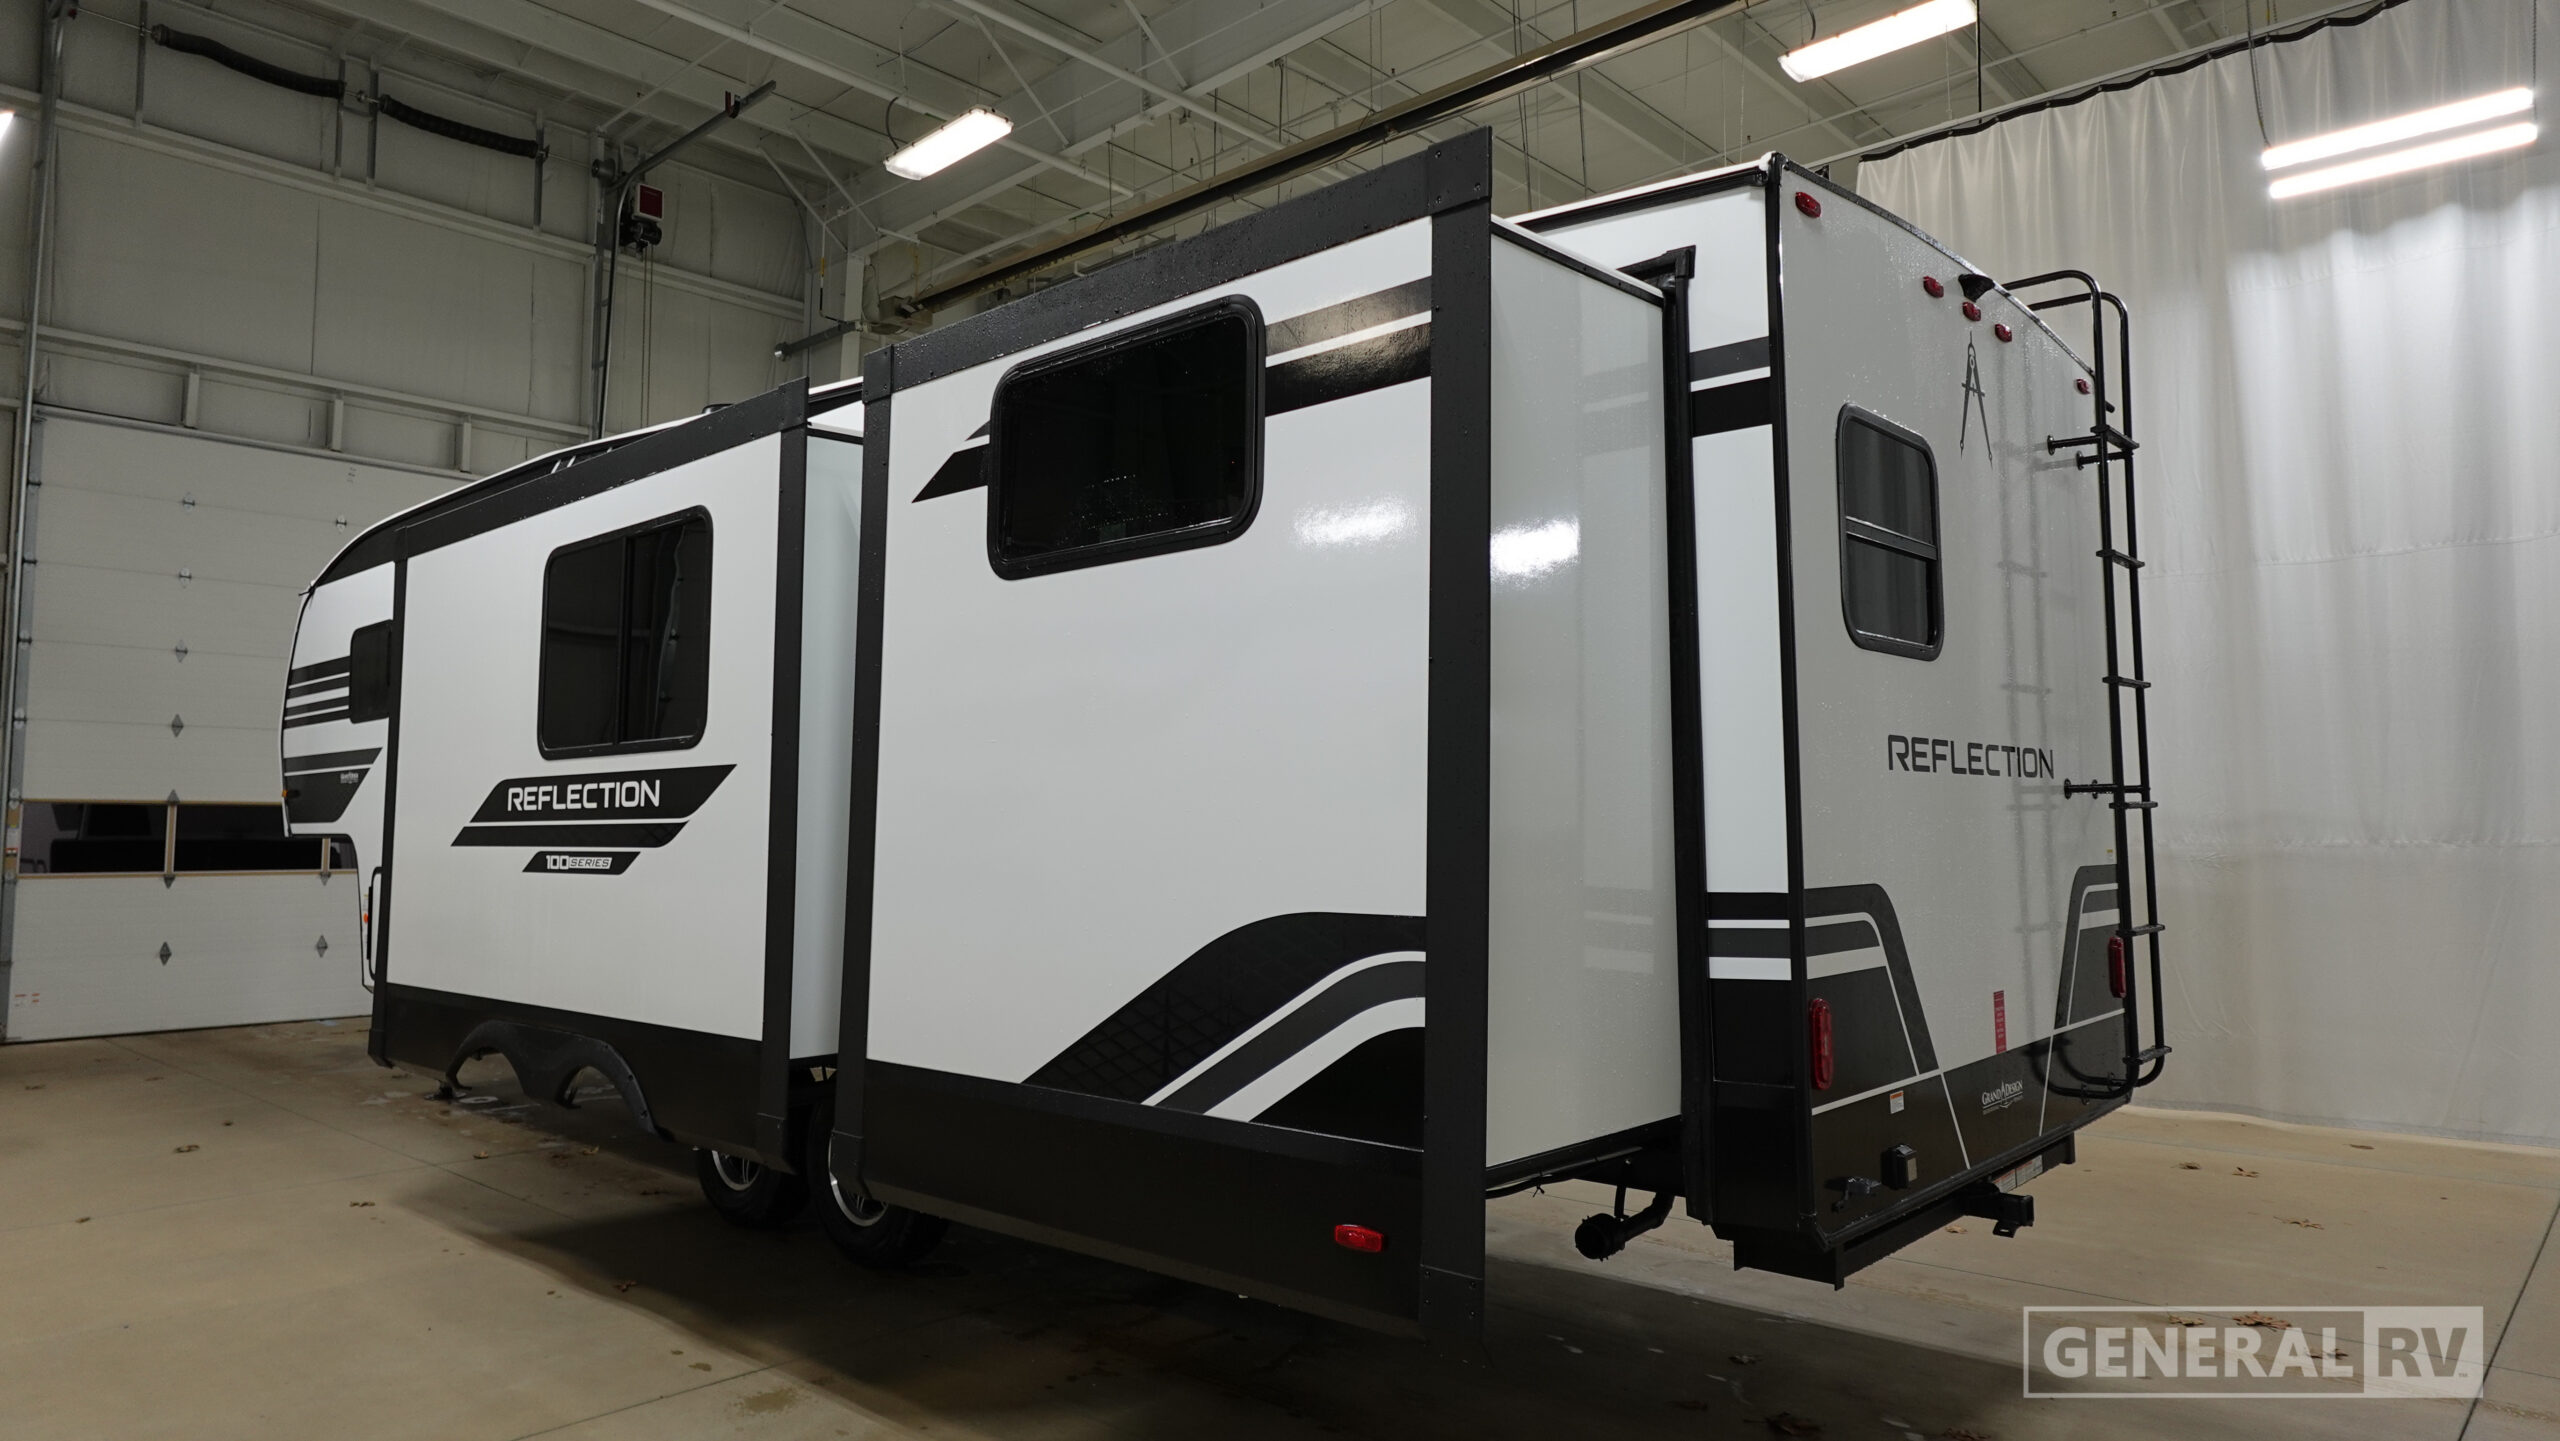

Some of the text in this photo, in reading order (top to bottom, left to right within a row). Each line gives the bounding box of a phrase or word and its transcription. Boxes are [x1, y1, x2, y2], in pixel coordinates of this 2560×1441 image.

[1888, 734, 2055, 779] REFLECTION
[507, 779, 661, 812] REFLECTION
[545, 855, 610, 870] 100 SERIES
[1982, 1089, 2001, 1105] GRAND
[2005, 1081, 2023, 1096] DESIGN
